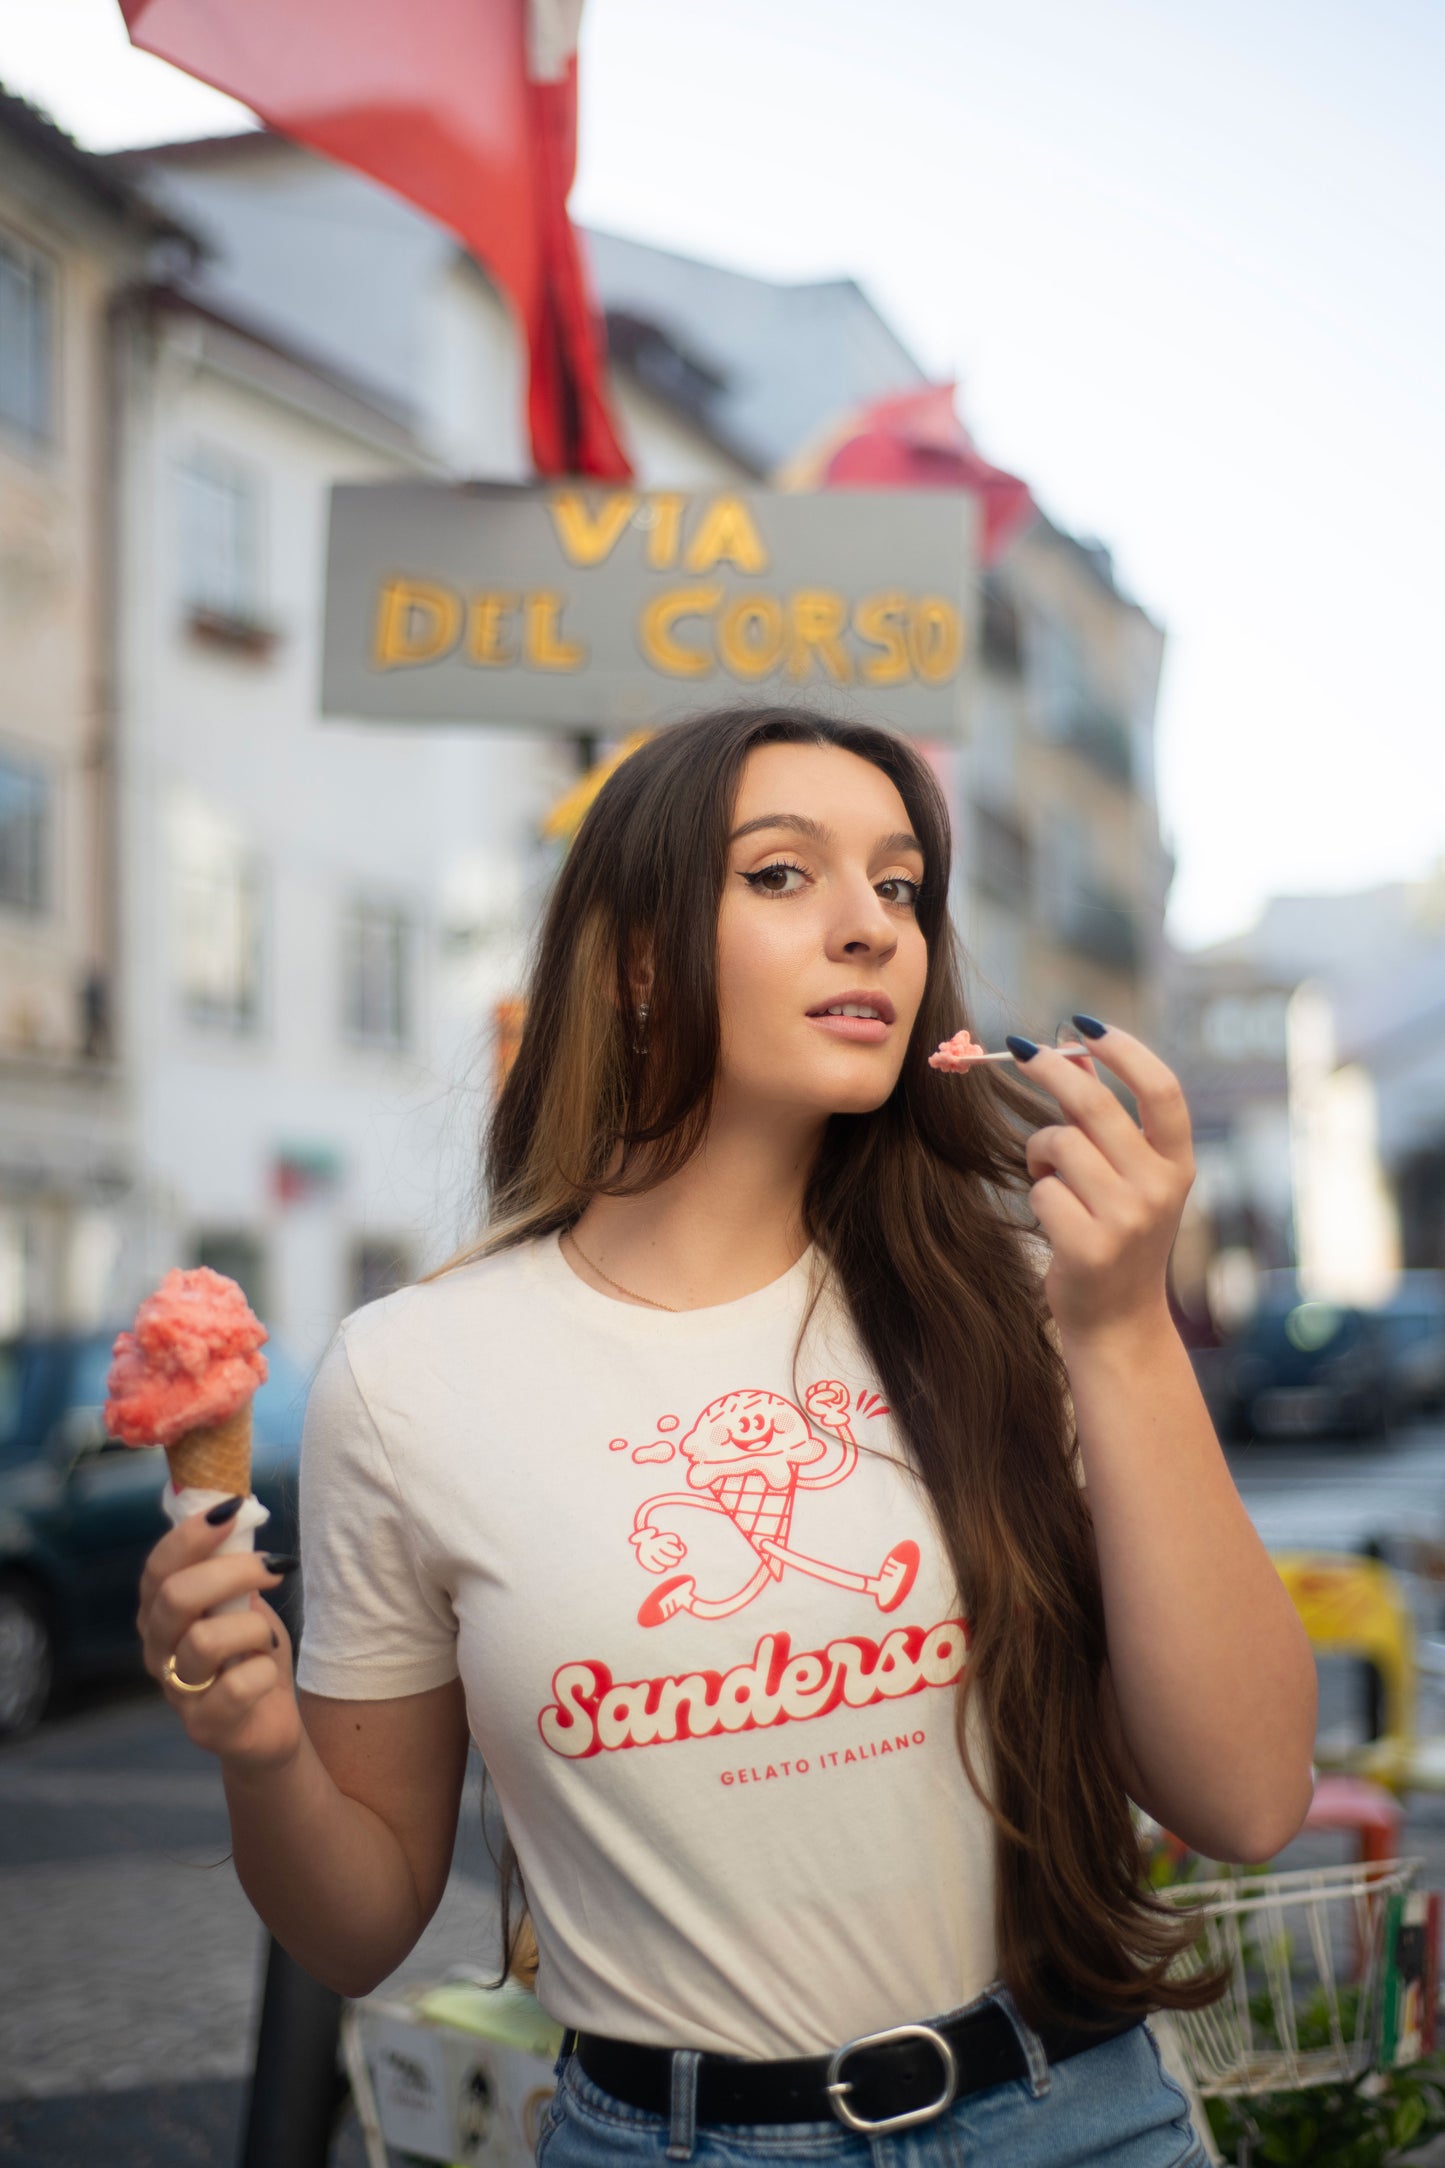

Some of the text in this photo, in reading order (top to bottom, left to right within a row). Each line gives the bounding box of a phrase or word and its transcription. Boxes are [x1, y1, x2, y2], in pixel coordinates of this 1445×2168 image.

[549, 488, 771, 574] VIA
[373, 576, 963, 686] DEL CORSO
[538, 1617, 970, 1759] Sanderso
[720, 1730, 926, 1786] GELATO ITALIANO
